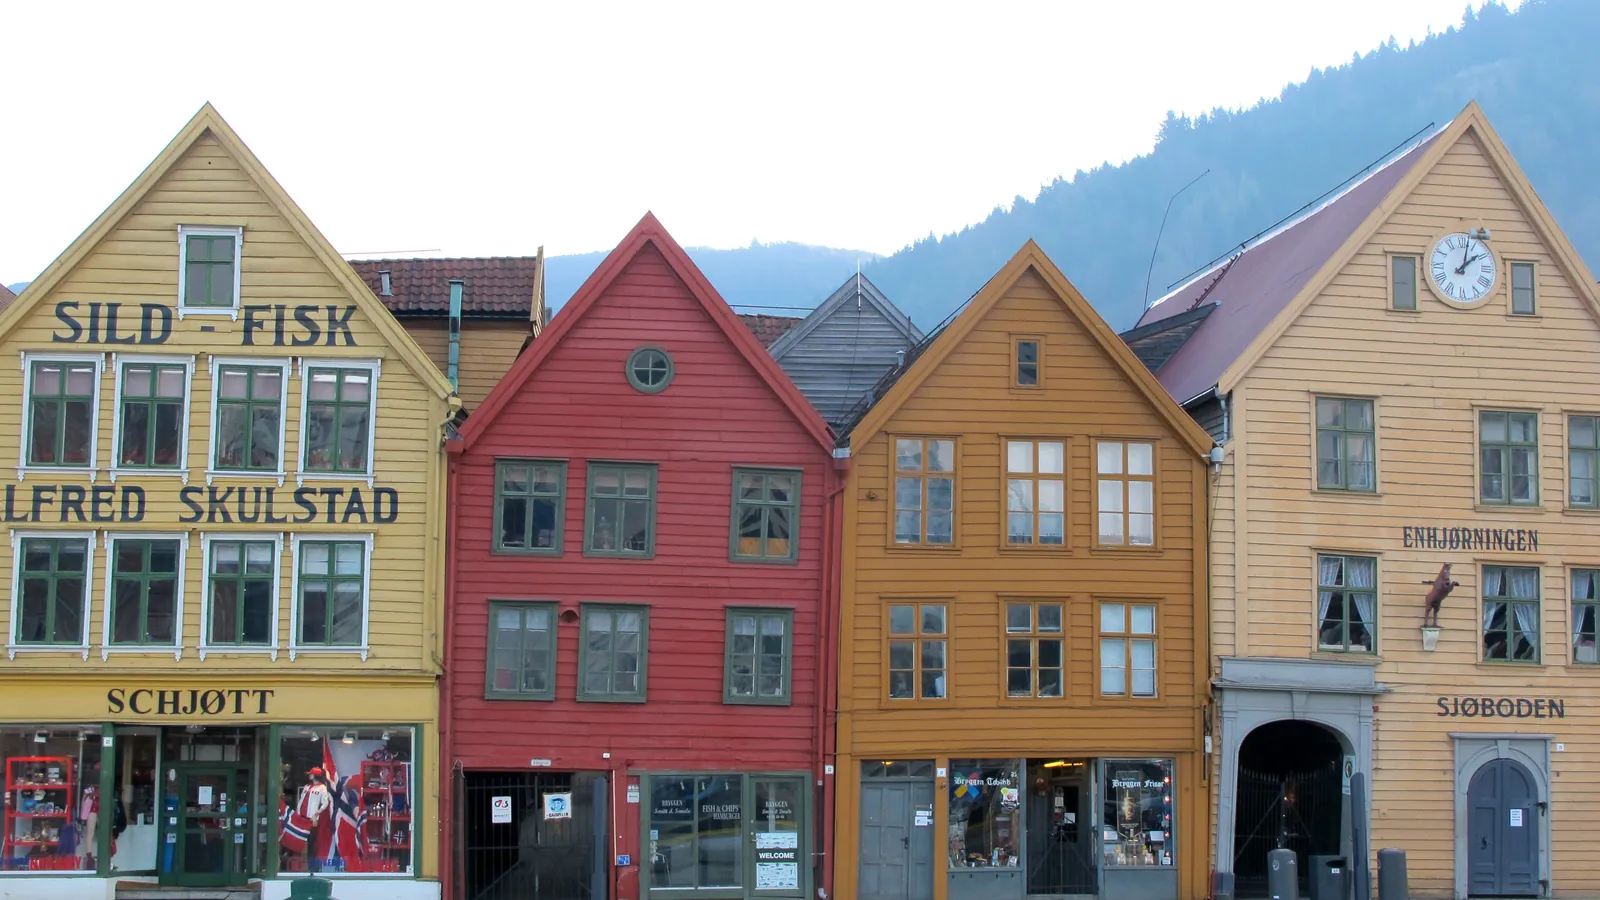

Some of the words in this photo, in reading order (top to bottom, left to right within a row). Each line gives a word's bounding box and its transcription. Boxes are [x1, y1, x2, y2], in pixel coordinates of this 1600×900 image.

[53, 301, 173, 344] SILD
[241, 304, 358, 346] FISK
[0, 484, 146, 523] LFRED
[179, 486, 399, 524] SKULSTAD
[1403, 525, 1539, 552] ENHJØRNINGEN
[107, 688, 275, 716] SCHJØTT
[1437, 697, 1565, 719] SJØBODEN
[1111, 779, 1141, 788] Bryggen
[702, 804, 716, 812] FISH
[721, 804, 739, 812] CHIPS
